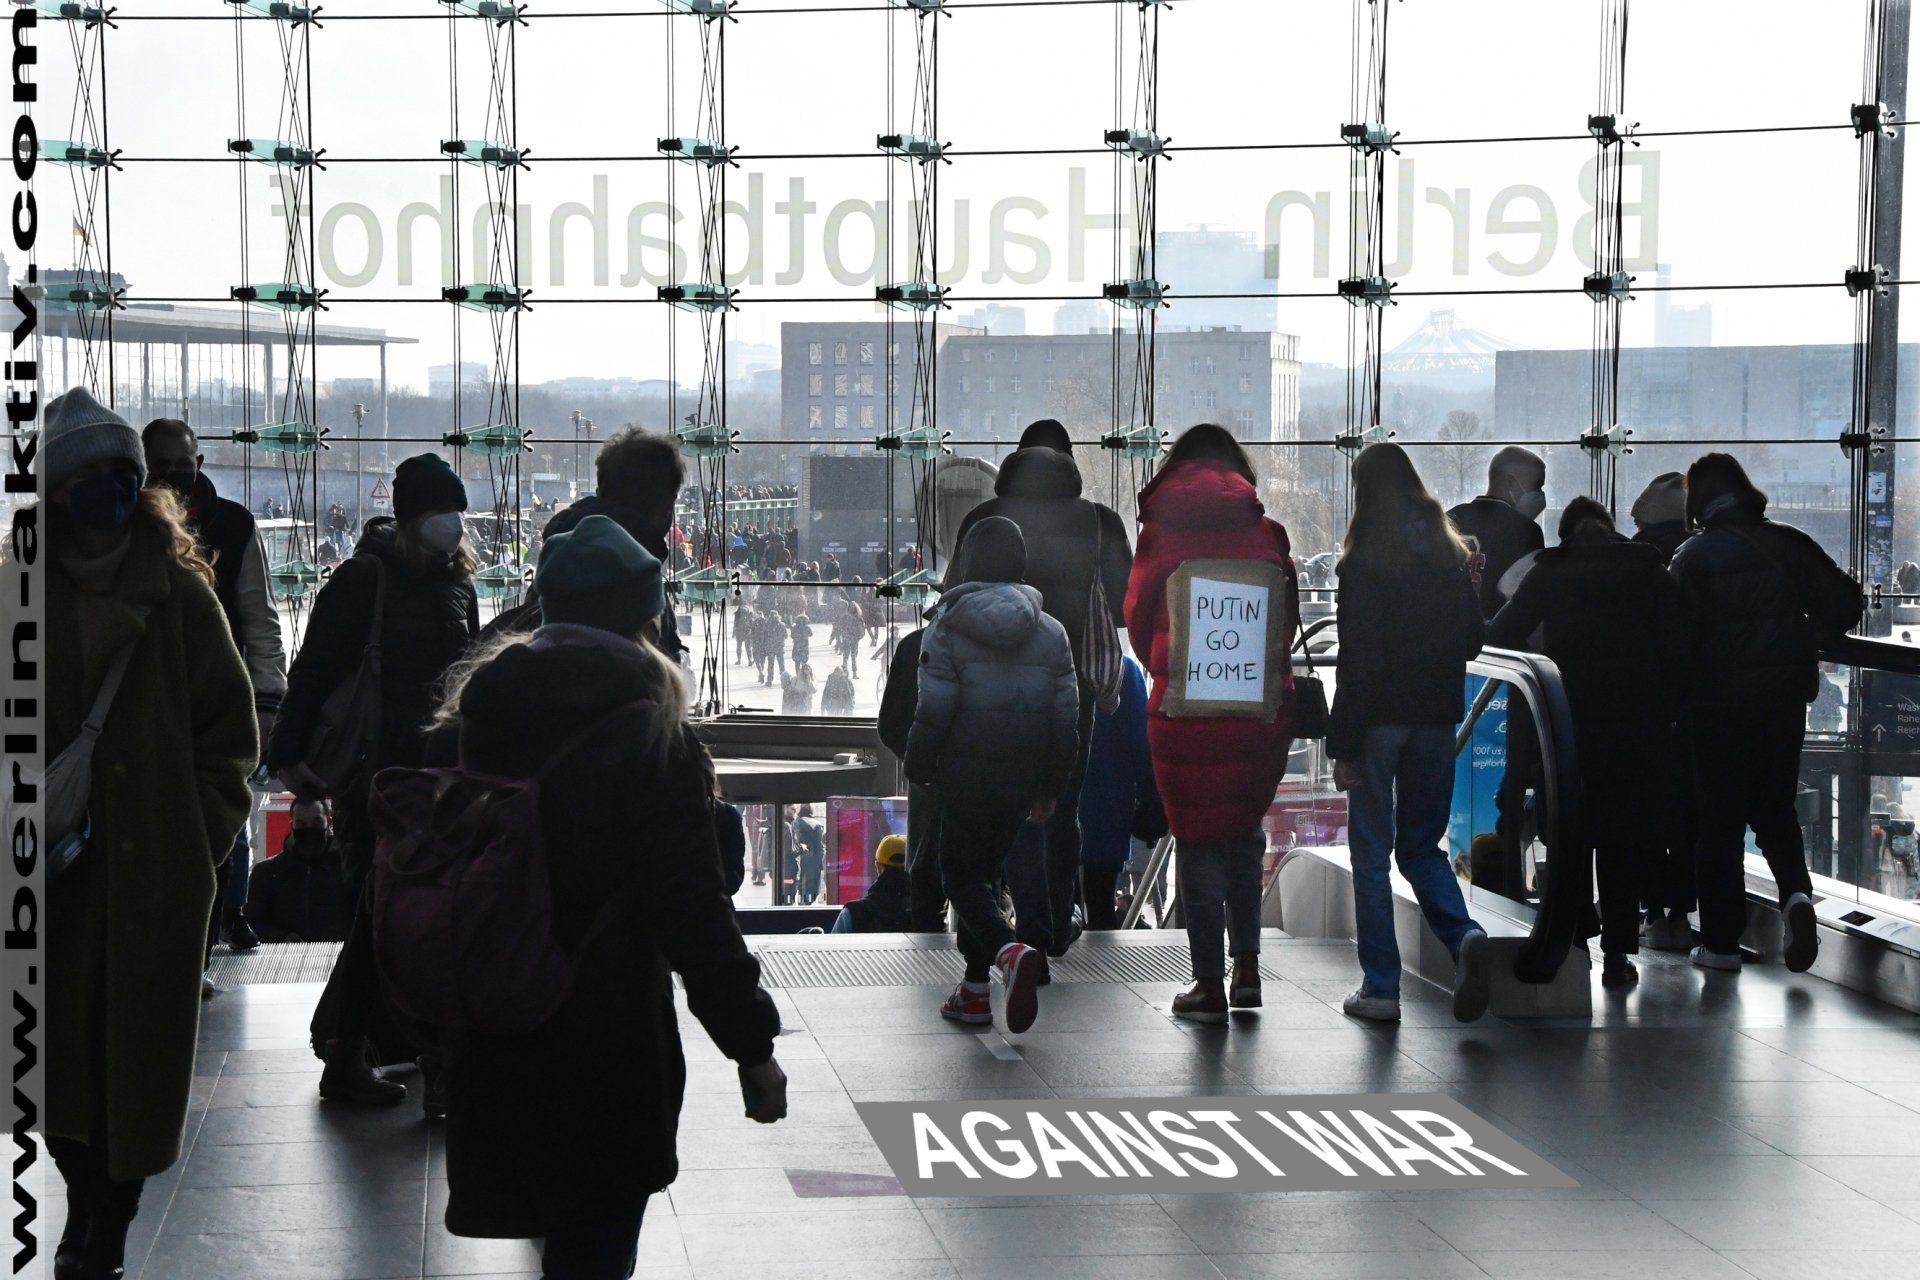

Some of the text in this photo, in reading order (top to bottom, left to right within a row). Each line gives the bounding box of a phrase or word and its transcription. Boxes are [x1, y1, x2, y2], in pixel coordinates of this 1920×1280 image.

[1197, 596, 1261, 623] PUTIN
[1206, 630, 1240, 651] GO
[1188, 662, 1258, 682] HOME
